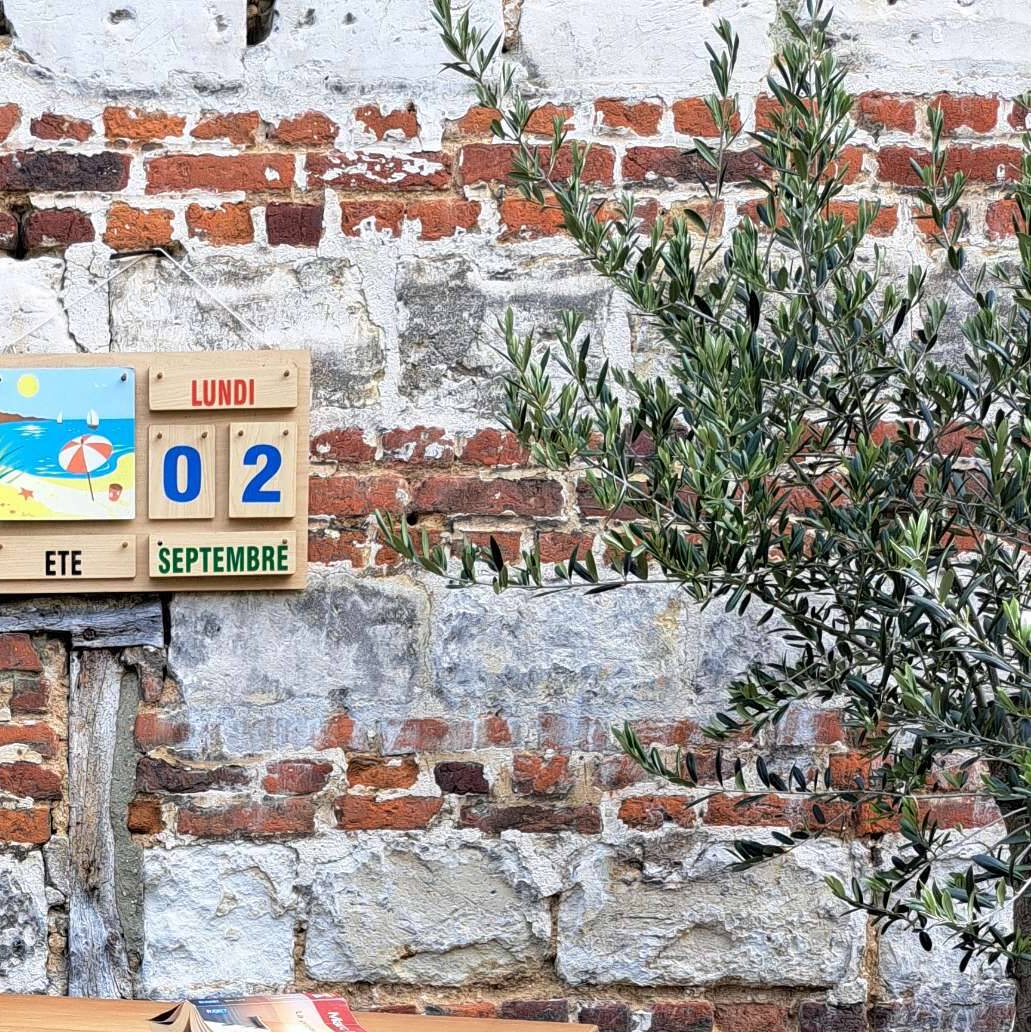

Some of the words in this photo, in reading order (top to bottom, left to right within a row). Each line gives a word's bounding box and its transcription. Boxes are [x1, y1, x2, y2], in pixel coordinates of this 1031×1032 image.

[191, 379, 255, 406] LUNDI
[45, 550, 83, 576] ETE
[159, 545, 288, 574] SEPTEMBRE
[327, 1010, 350, 1031] Marc
